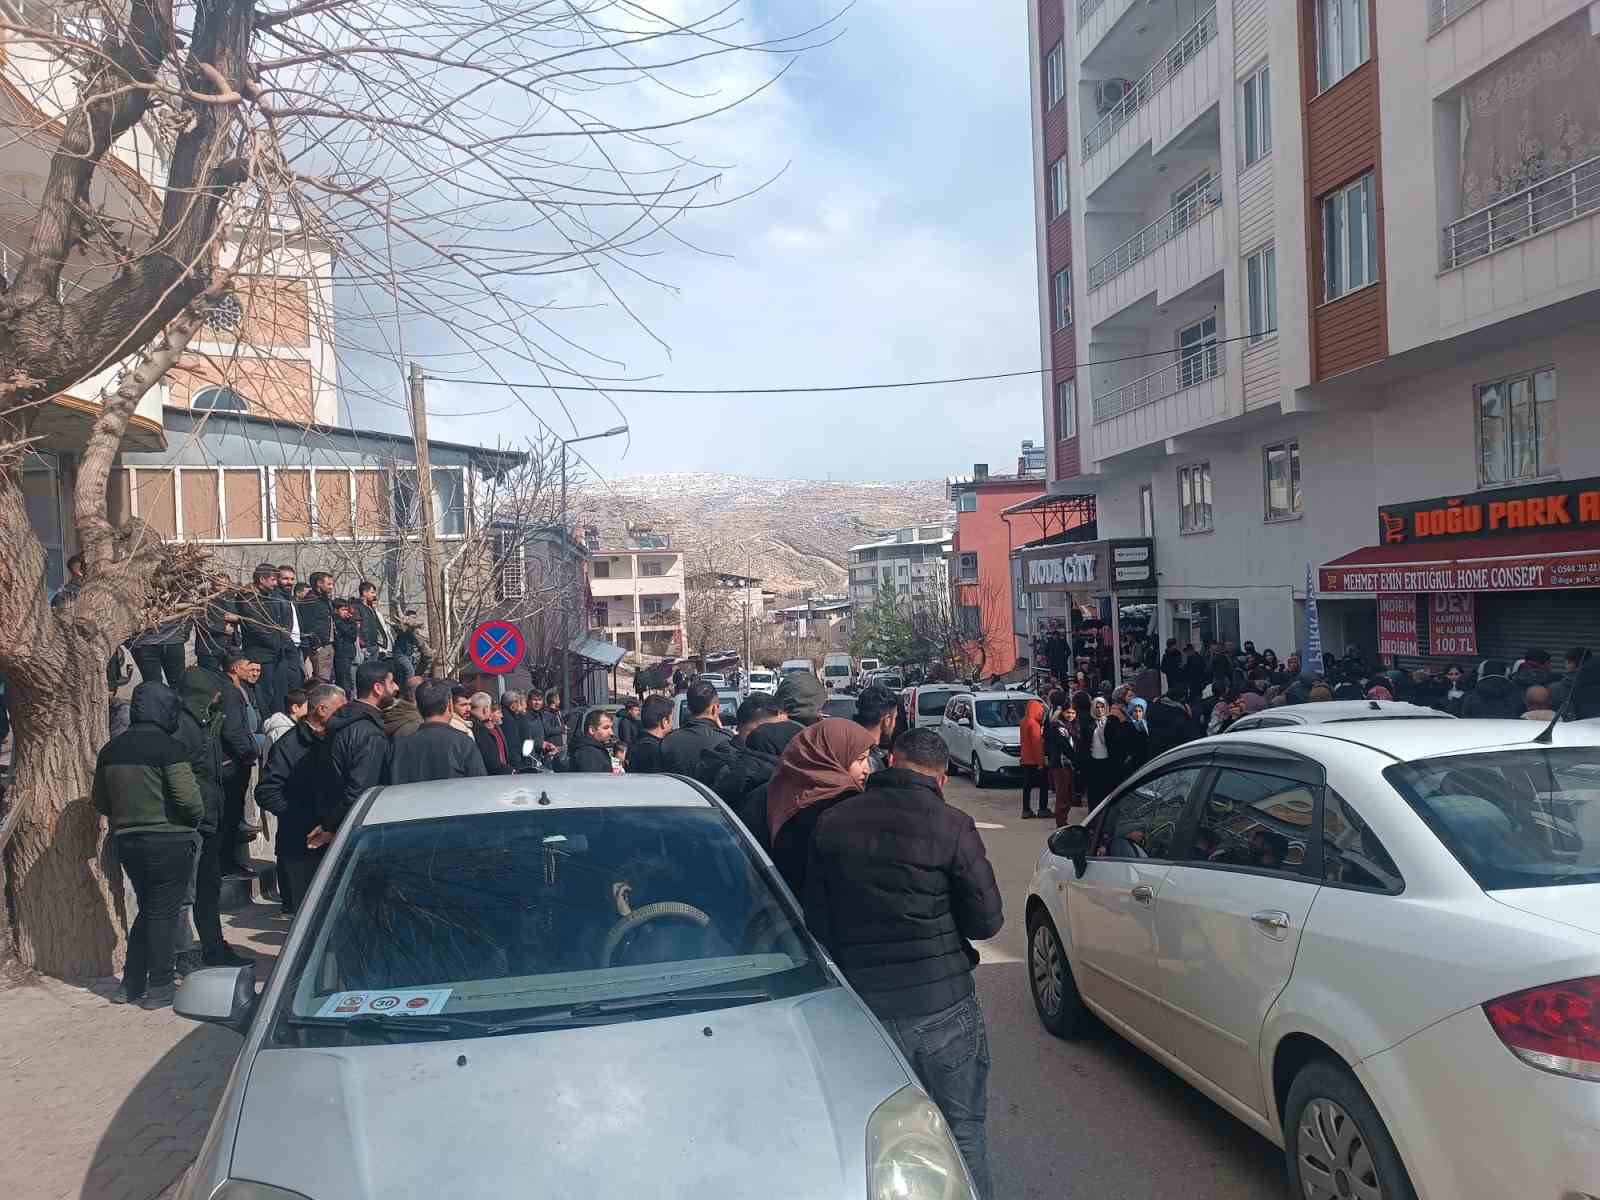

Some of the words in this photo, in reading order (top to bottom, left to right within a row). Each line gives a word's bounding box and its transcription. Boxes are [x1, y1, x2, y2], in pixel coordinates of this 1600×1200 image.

[1414, 498, 1483, 537] DOĞU
[1488, 494, 1572, 530] PARK
[1343, 572, 1379, 591] MEHMET
[1404, 567, 1456, 590] ERTUĞRUL
[1457, 568, 1489, 589] HOME
[1491, 565, 1545, 588] CONSEPT
[1434, 593, 1474, 613] DEV
[1380, 615, 1416, 634] İNDİRİM
[1380, 636, 1417, 656] İNDİRİM
[1435, 638, 1456, 652] 100
[1460, 638, 1473, 652] TL
[376, 999, 394, 1007] 30
